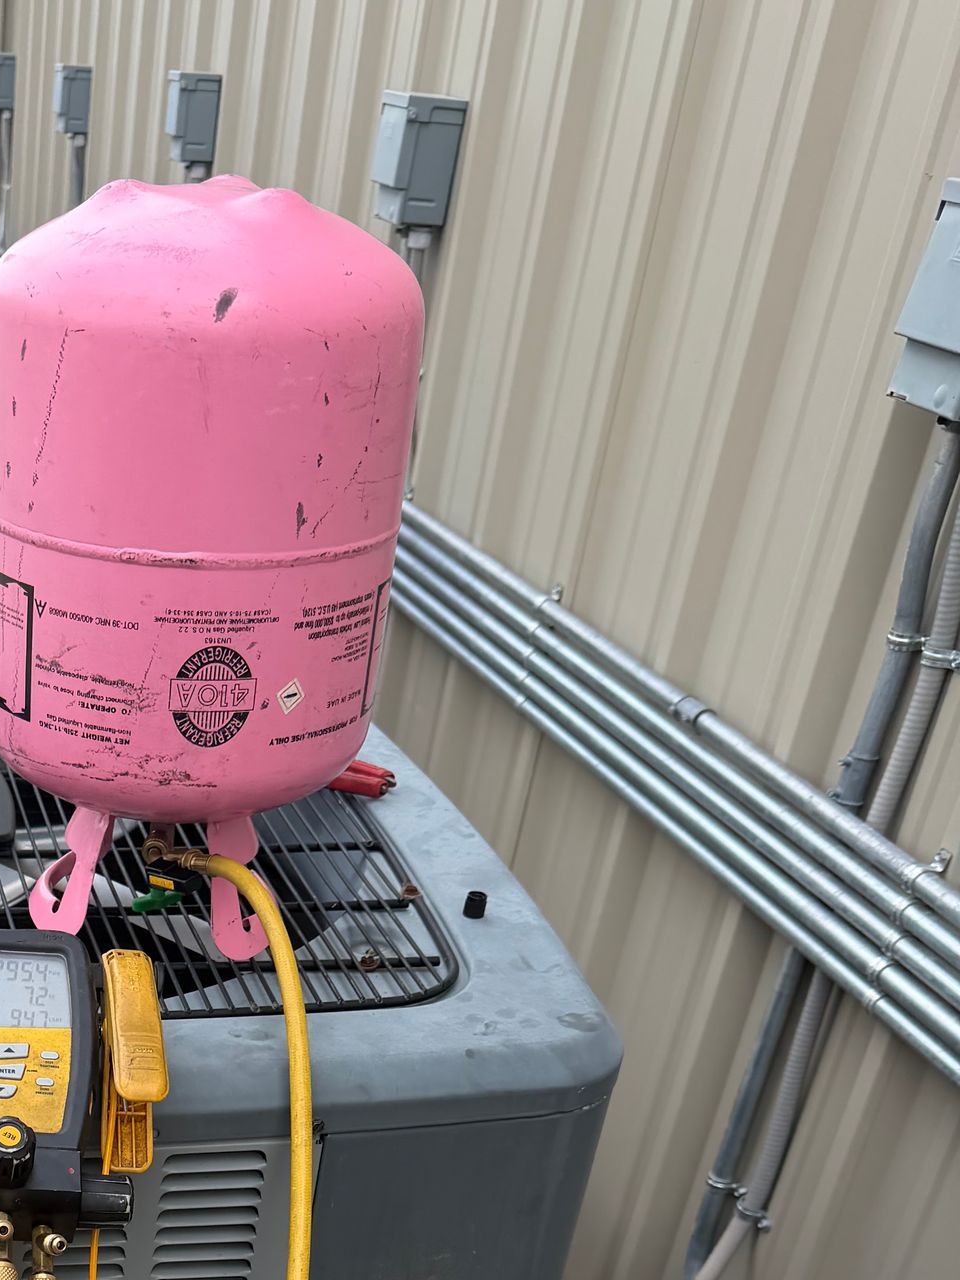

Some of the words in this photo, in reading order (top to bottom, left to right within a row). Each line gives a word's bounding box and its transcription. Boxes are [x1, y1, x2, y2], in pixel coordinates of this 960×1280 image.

[253, 608, 272, 616] (CAS#
[68, 612, 94, 624] 400/500
[95, 616, 111, 627] NRC
[153, 616, 216, 624] PENTAFLUOROETHANE
[229, 616, 280, 625] DIFLUOROMETHANE
[112, 619, 139, 631] DOT-39
[293, 622, 304, 632] and
[308, 627, 339, 641] transportation
[181, 648, 248, 678] REFRIGERANT
[59, 687, 75, 696] hose
[76, 690, 104, 703] charging
[176, 683, 249, 708] 410A
[77, 701, 117, 714] OPERATE:
[46, 713, 57, 722] Gas
[175, 716, 242, 746] REFRIGERANT
[80, 732, 112, 744] WEIGHT
[113, 737, 130, 745] NET
[268, 736, 290, 747] ONLY
[290, 733, 305, 743] USE
[24, 985, 49, 1007] 7.2
[1, 1131, 17, 1141] REF
